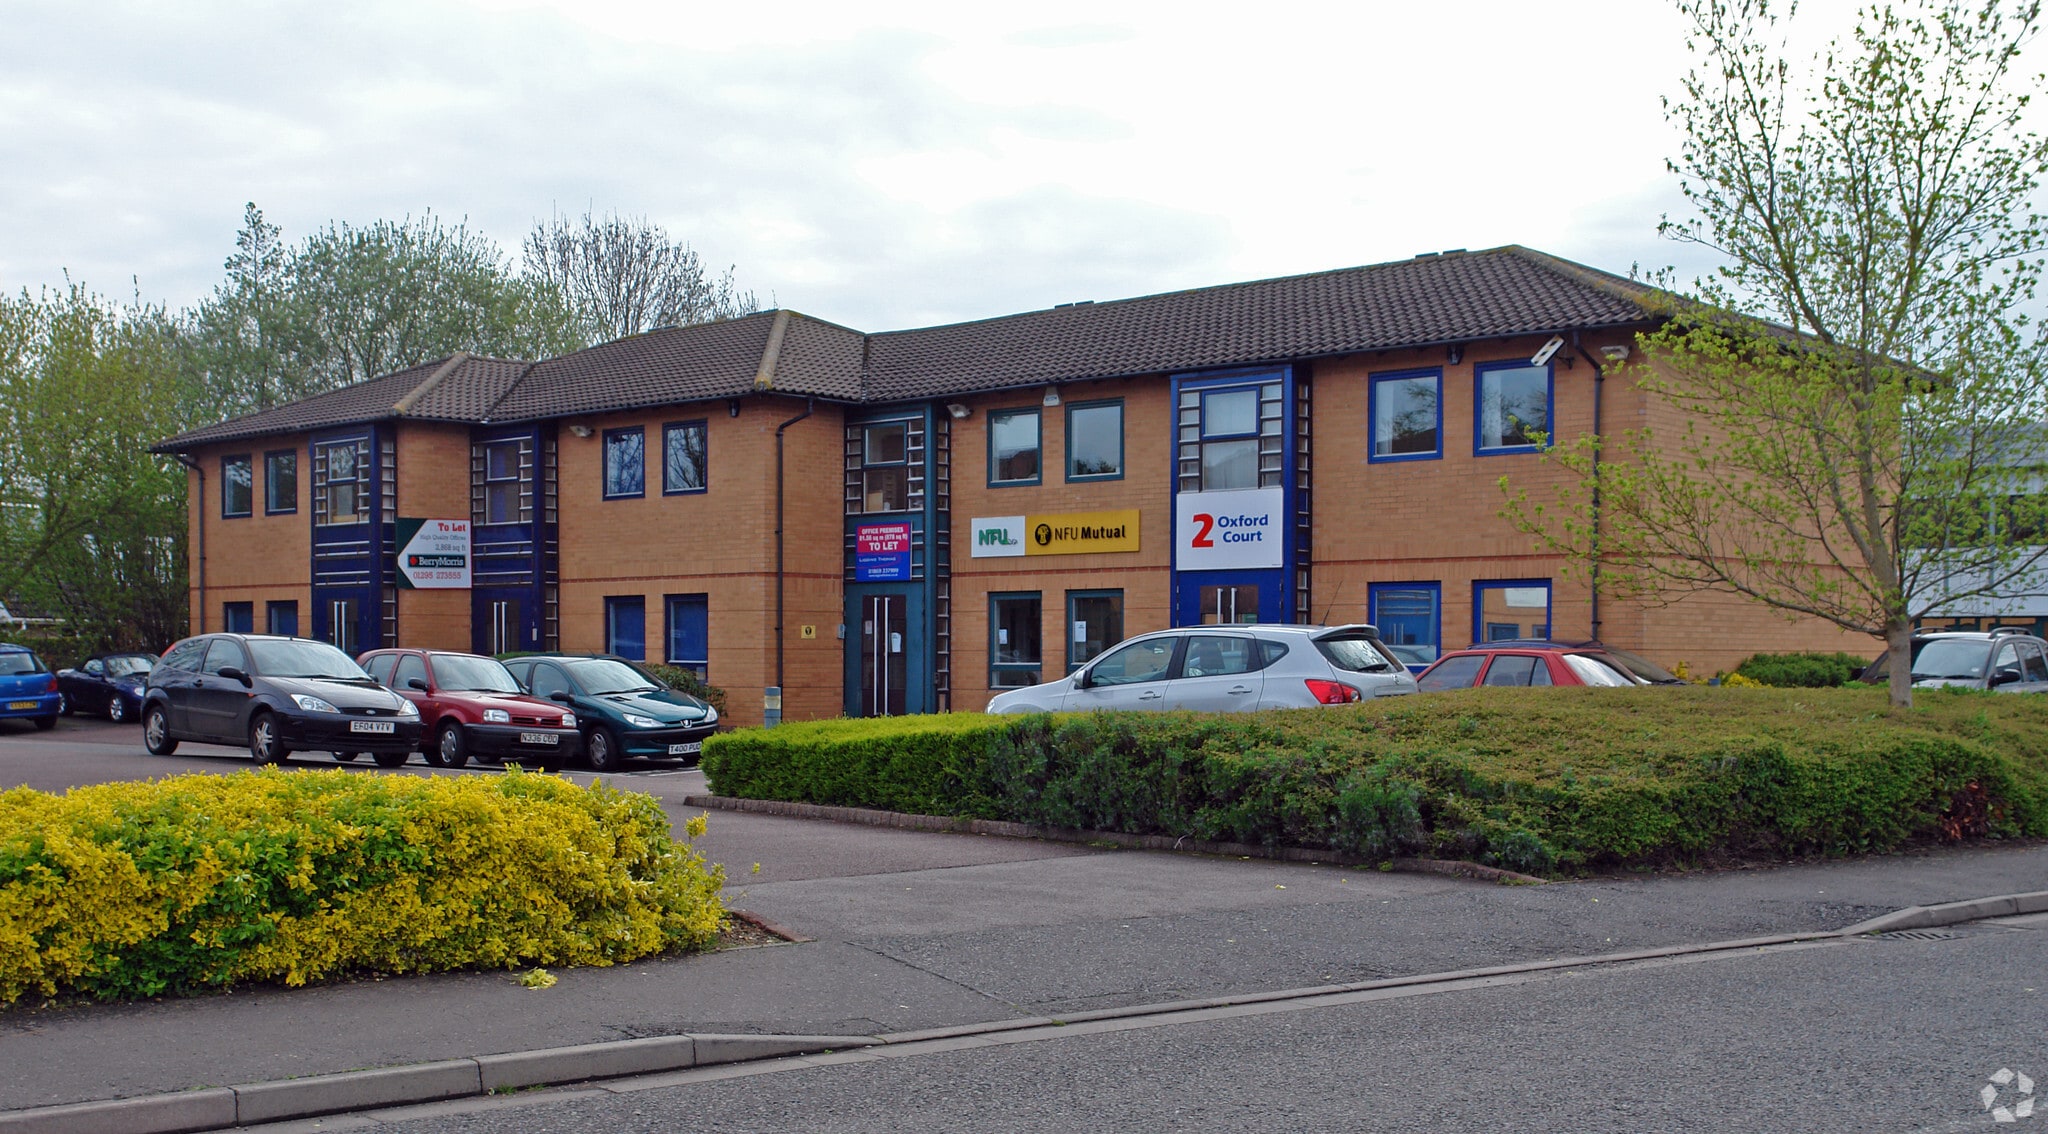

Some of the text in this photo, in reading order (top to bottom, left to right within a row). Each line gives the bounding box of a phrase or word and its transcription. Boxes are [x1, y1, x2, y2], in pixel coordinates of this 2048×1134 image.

[438, 522, 466, 532] To Let
[1217, 514, 1269, 528] Oxford
[978, 528, 1008, 546] NFU
[1054, 525, 1126, 541] NFU Mutual
[1191, 513, 1214, 548] 2
[1222, 530, 1262, 543] Court
[869, 541, 898, 551] TO LET
[418, 556, 464, 568] BerryMorris
[670, 744, 689, 753] T400
